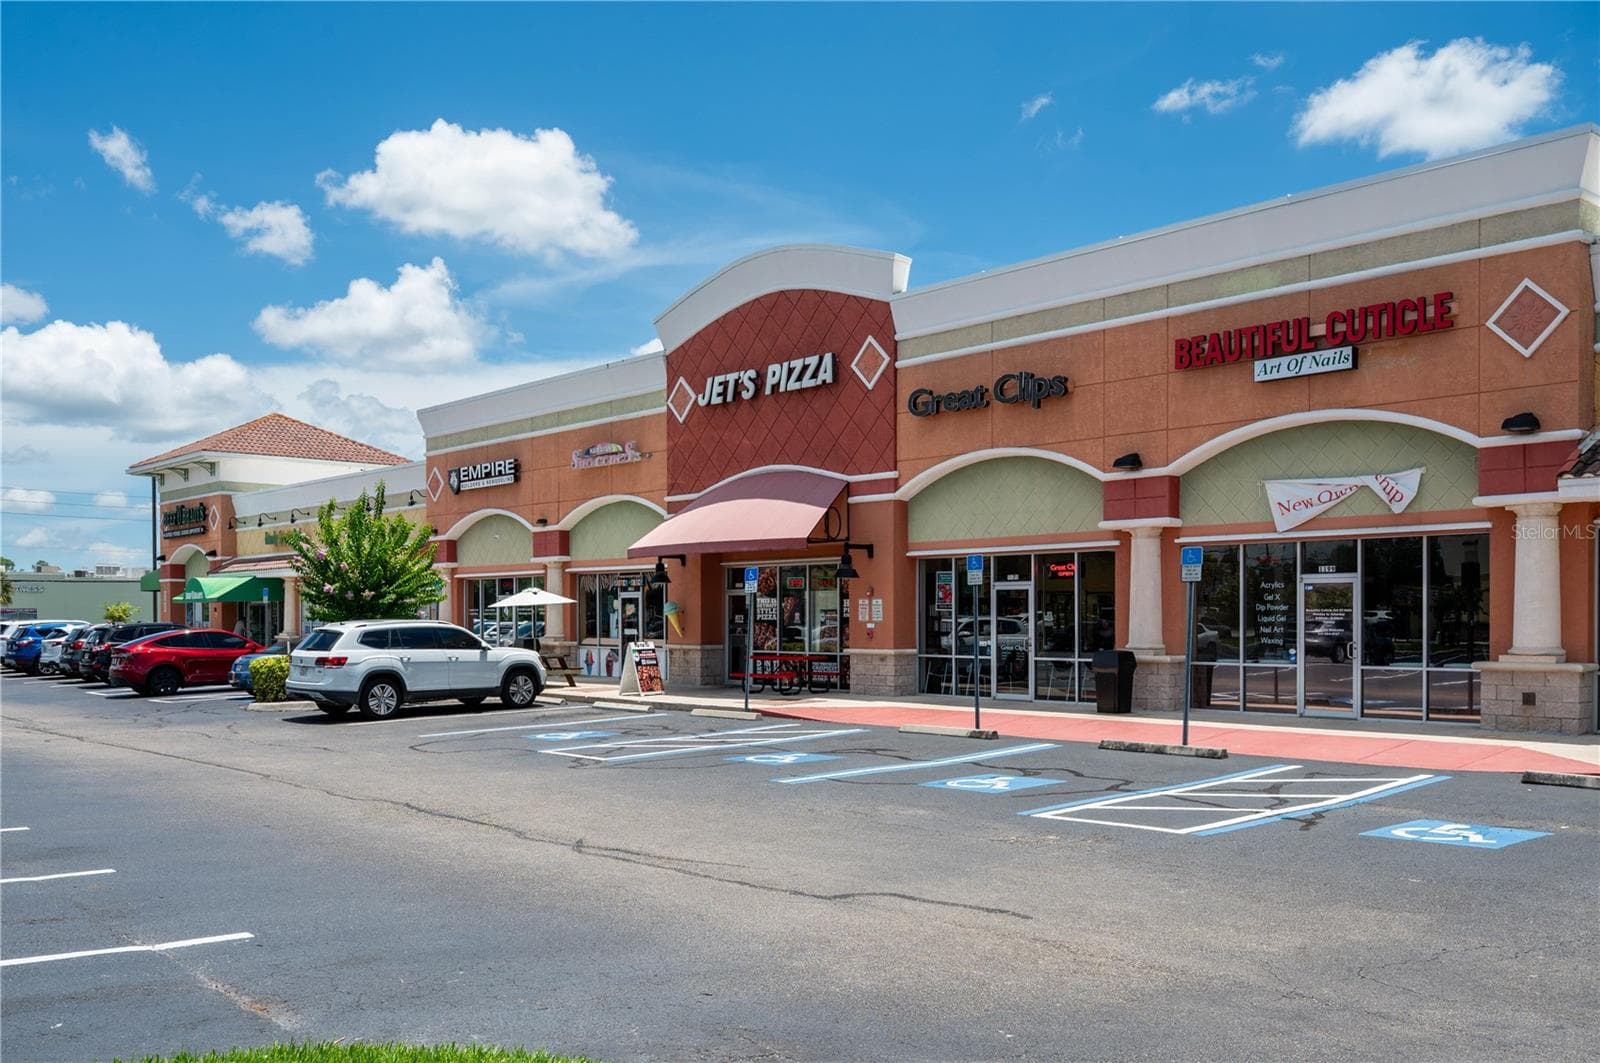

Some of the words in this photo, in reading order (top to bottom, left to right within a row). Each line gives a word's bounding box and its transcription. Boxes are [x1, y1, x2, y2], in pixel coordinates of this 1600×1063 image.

[1174, 316, 1316, 371] BEAUTIFUL
[1325, 291, 1454, 347] CUTICLE
[1257, 359, 1282, 377] Art
[1287, 356, 1304, 374] Of
[1308, 349, 1350, 370] Nails
[697, 368, 757, 407] JET'S
[765, 352, 834, 395] PIZZA
[907, 384, 988, 417] Great
[993, 371, 1069, 409] Clips
[460, 458, 515, 481] EMPIRE
[1276, 497, 1314, 516] New
[1260, 581, 1285, 590] Acrylics
[1263, 593, 1273, 601] Gel
[1266, 603, 1289, 611] Powder
[1257, 615, 1275, 624] Liquid
[1276, 614, 1286, 622] Gel
[1261, 637, 1283, 646] Waxing
